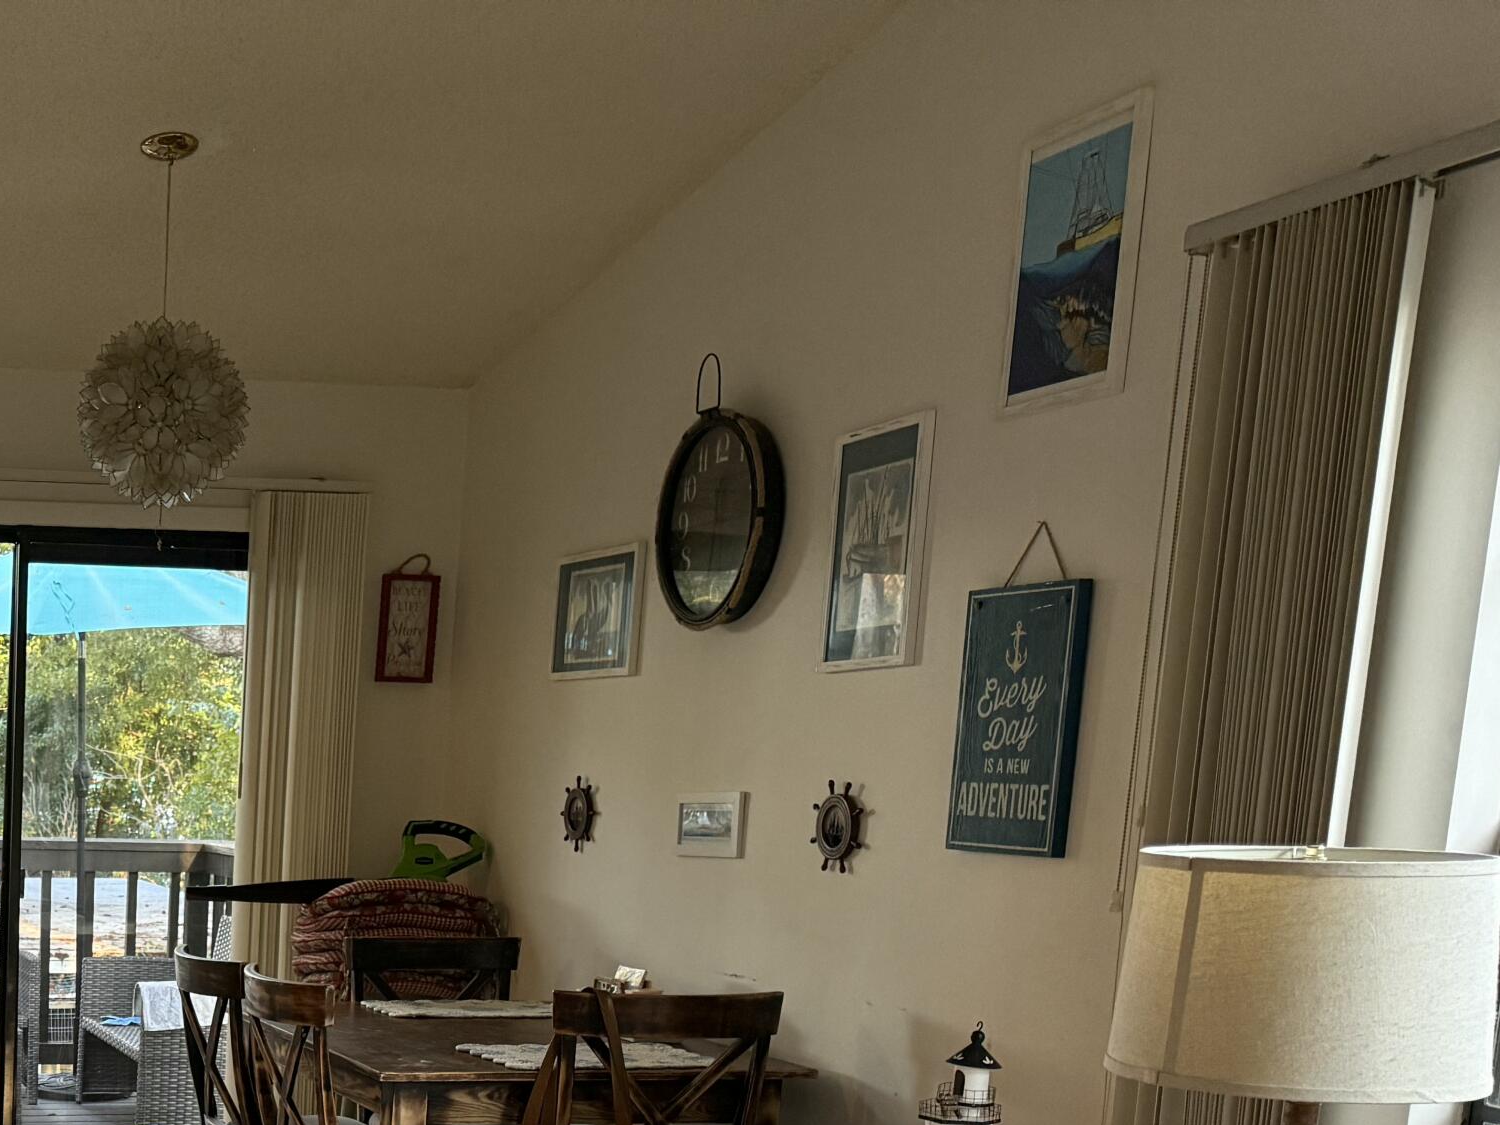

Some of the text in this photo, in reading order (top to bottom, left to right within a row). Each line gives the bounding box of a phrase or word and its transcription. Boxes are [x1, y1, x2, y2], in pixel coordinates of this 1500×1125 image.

[699, 443, 709, 472] 11
[716, 432, 730, 463] 12
[684, 474, 697, 503] 10
[977, 675, 1047, 718] Every
[982, 715, 1038, 751] Day
[983, 757, 1031, 775] IS A NEW
[956, 781, 1050, 821] ADVENTURE
